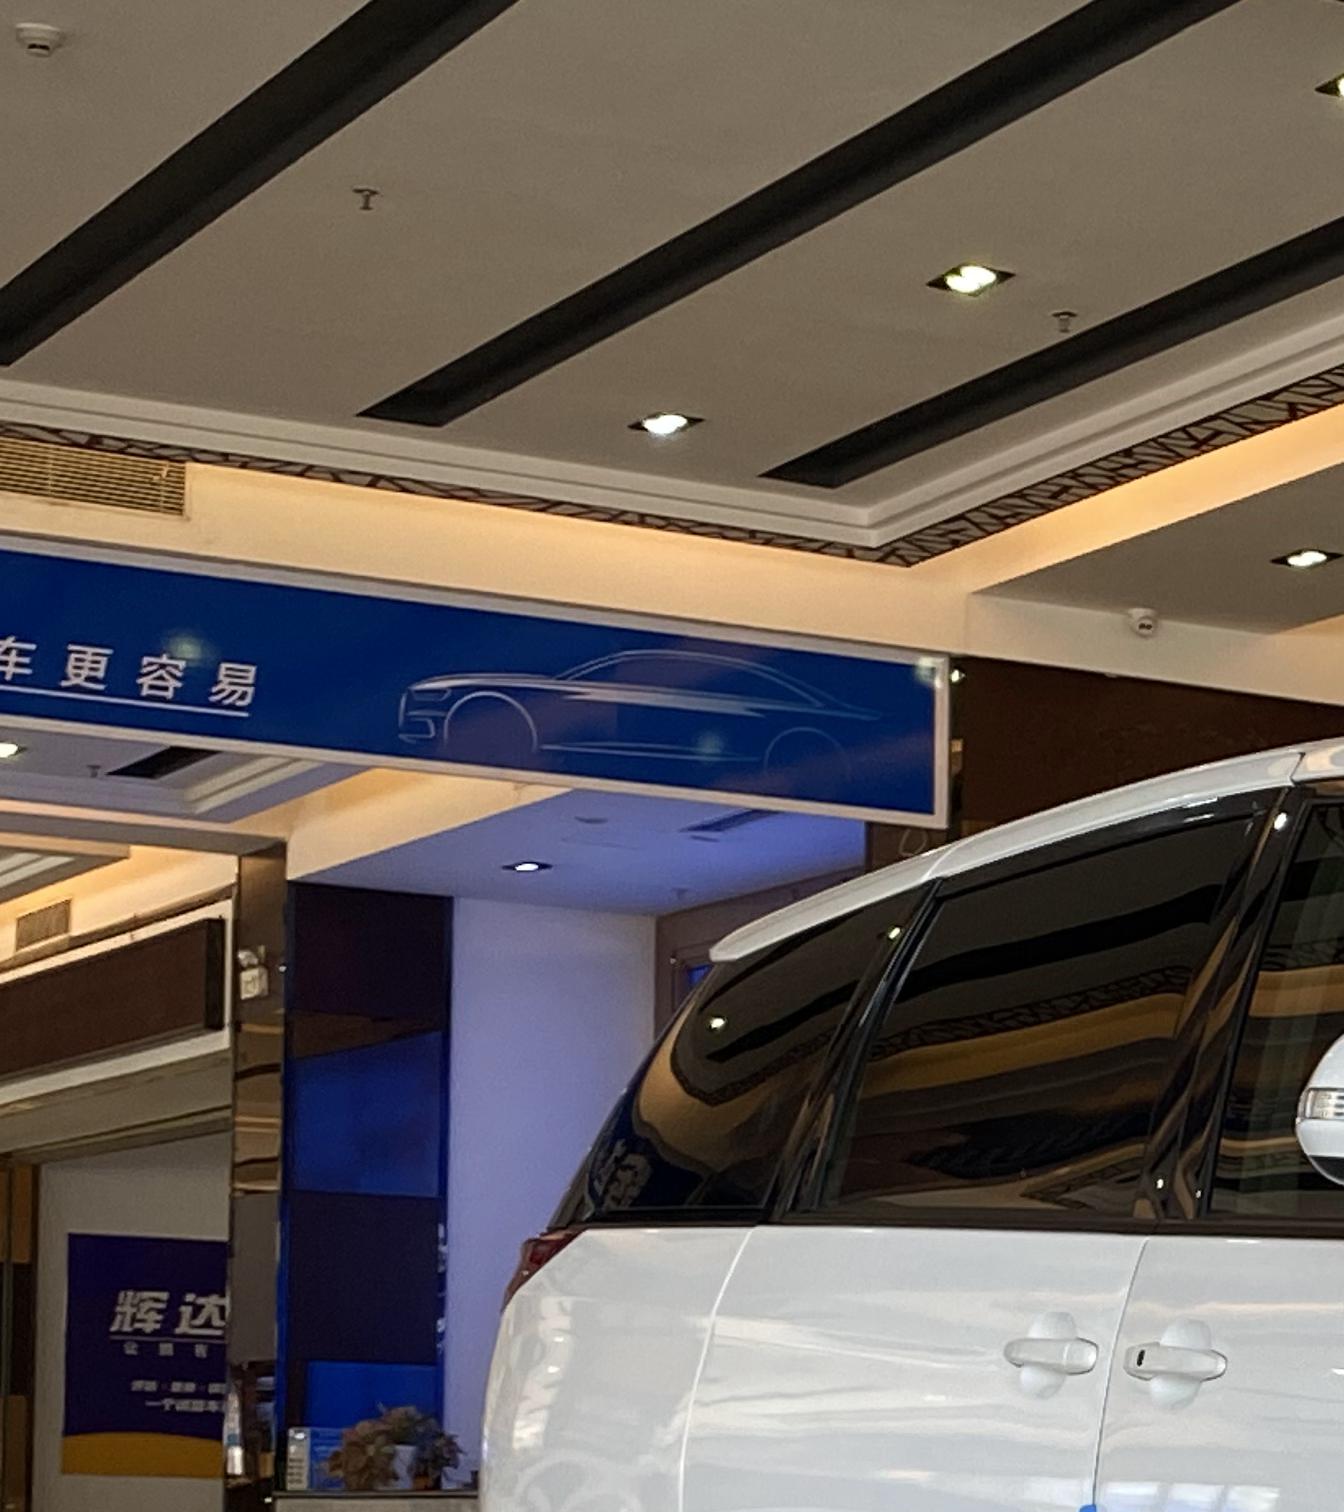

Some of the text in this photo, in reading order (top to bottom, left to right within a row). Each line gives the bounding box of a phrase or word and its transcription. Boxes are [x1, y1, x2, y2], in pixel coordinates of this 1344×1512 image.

[0, 636, 257, 707] 车更容易
[108, 1290, 228, 1335] 辉达
